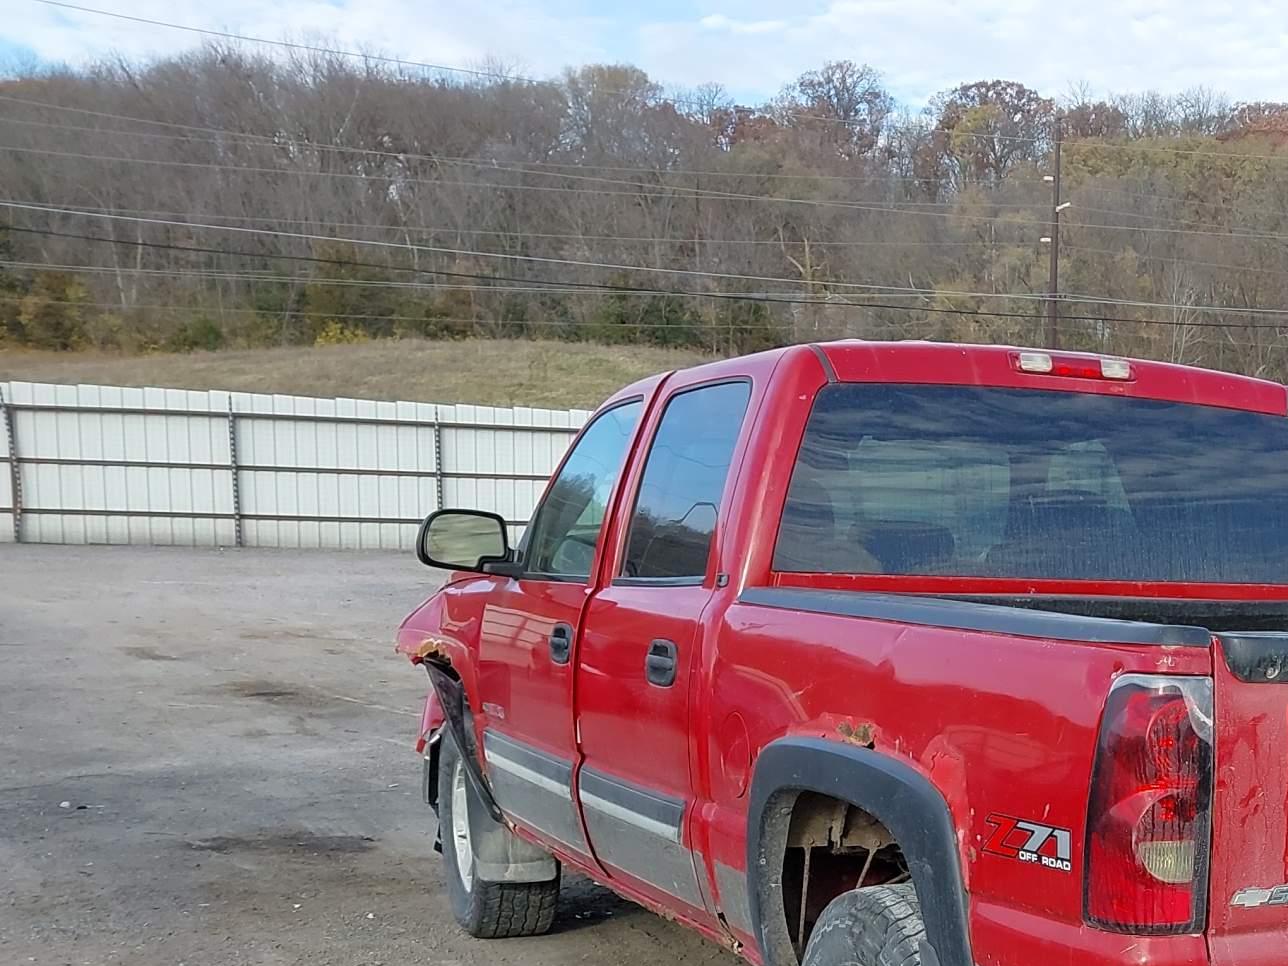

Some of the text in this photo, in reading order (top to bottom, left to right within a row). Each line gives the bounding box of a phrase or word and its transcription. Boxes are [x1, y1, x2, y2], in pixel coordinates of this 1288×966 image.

[982, 813, 1071, 860] Z71
[1019, 851, 1071, 871] OFF ROAD
